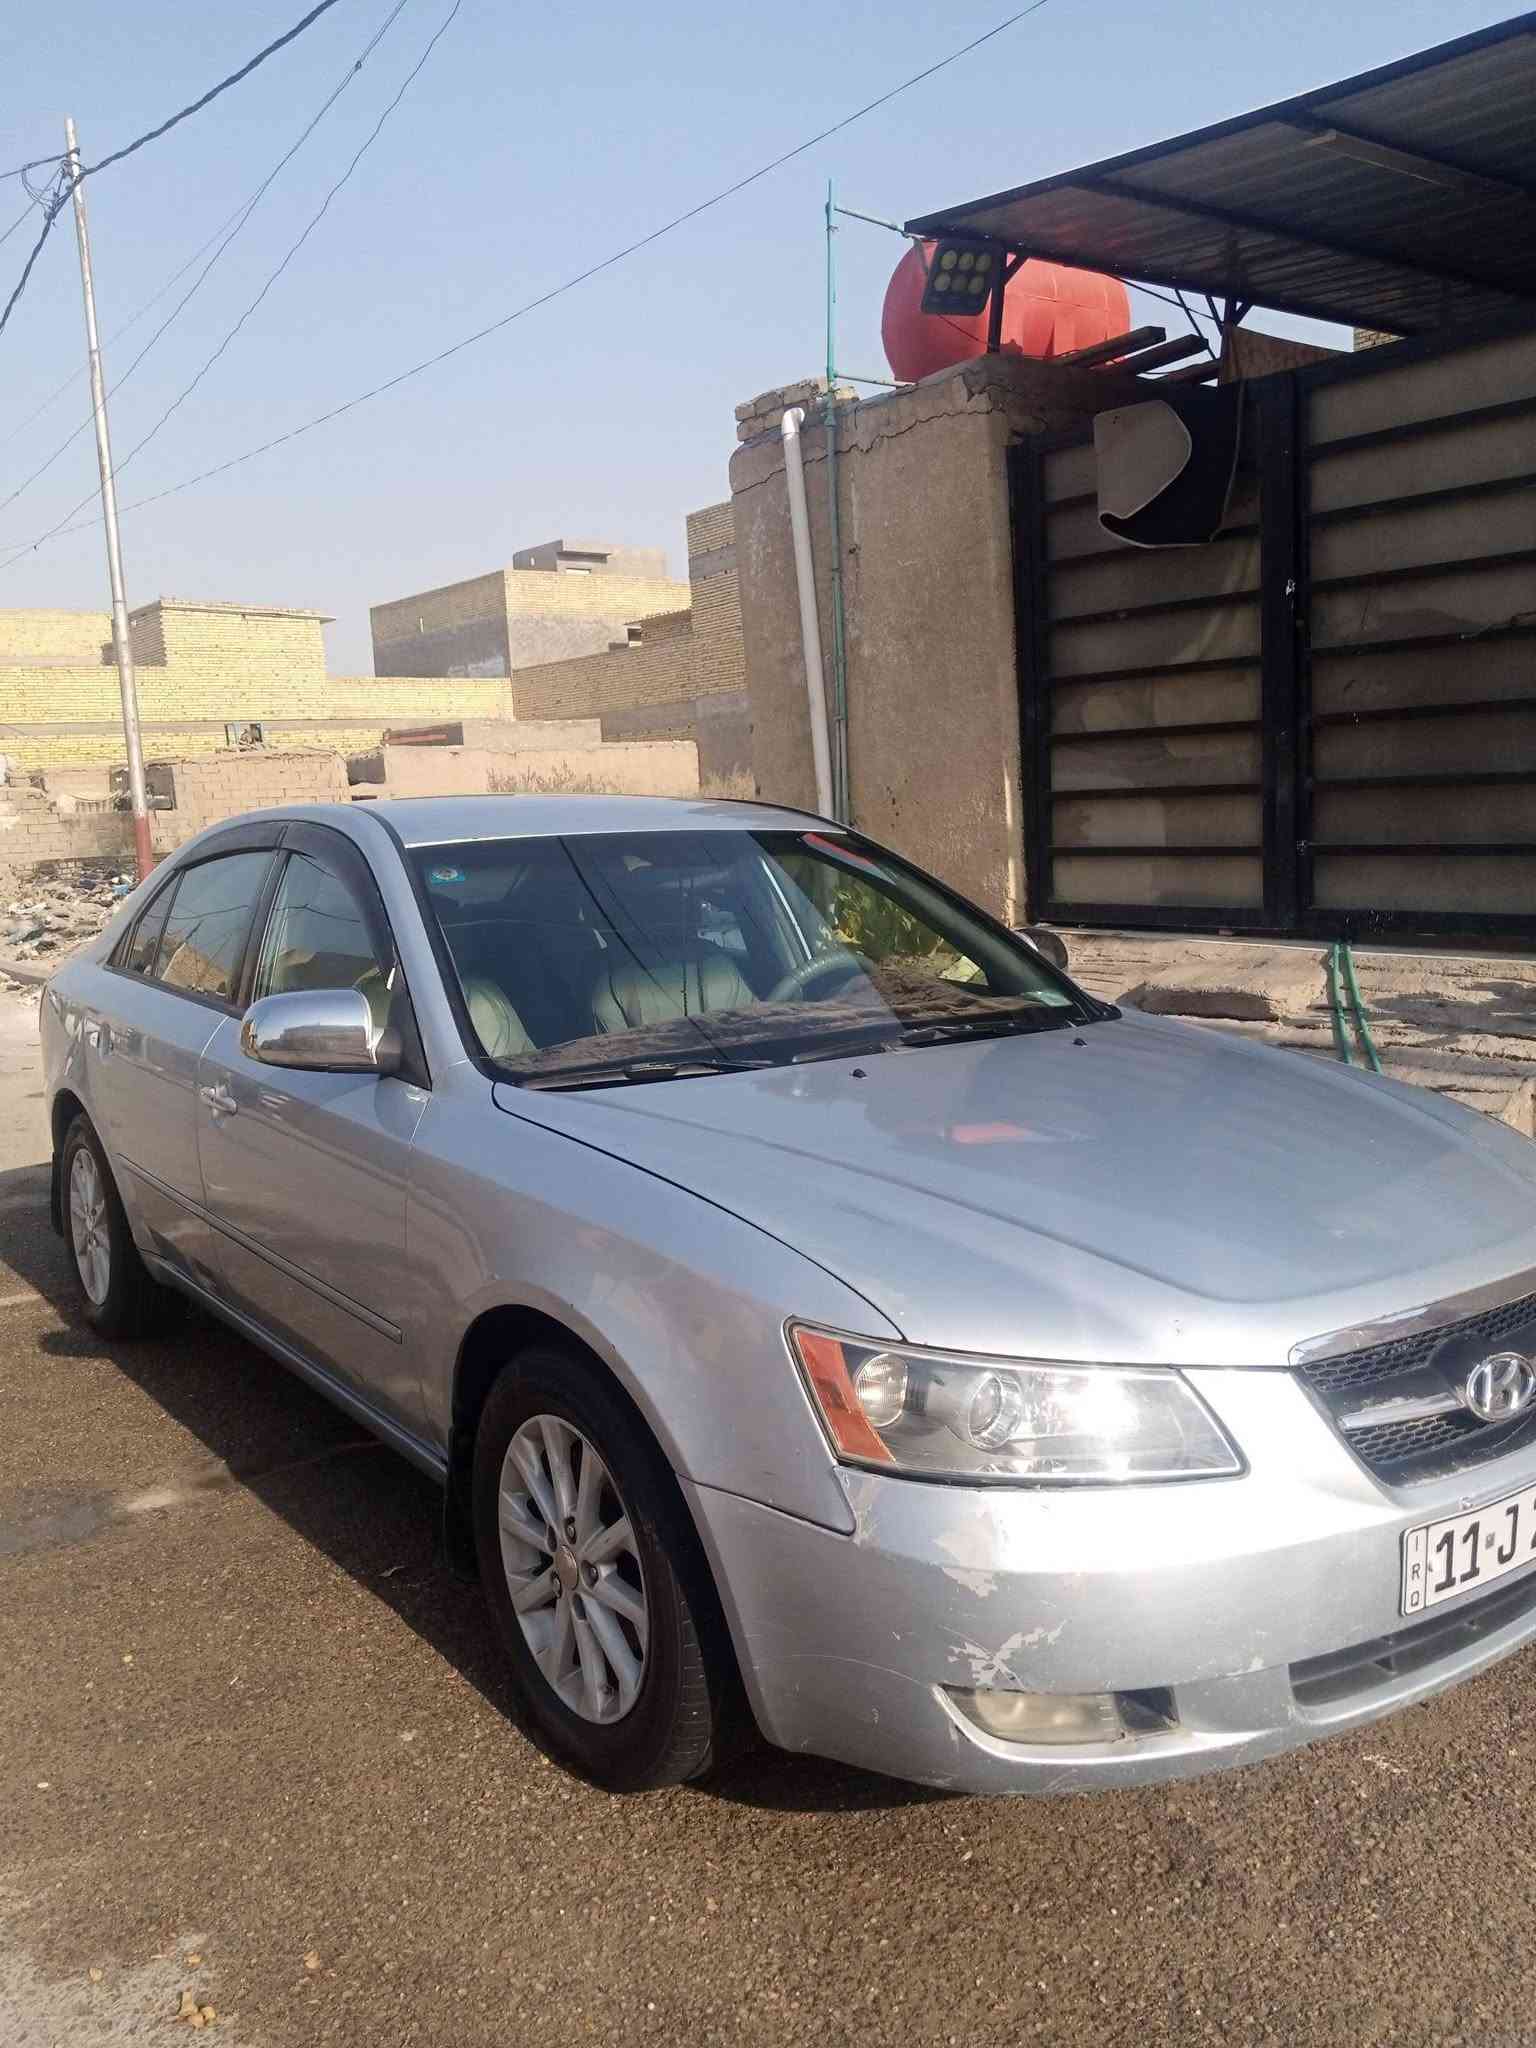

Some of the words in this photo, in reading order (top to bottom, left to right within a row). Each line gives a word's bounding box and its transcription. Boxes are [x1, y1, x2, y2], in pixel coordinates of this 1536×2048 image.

[1410, 1535, 1421, 1608] IRQ
[1434, 1520, 1480, 1593] 11
[1497, 1503, 1519, 1565] J
